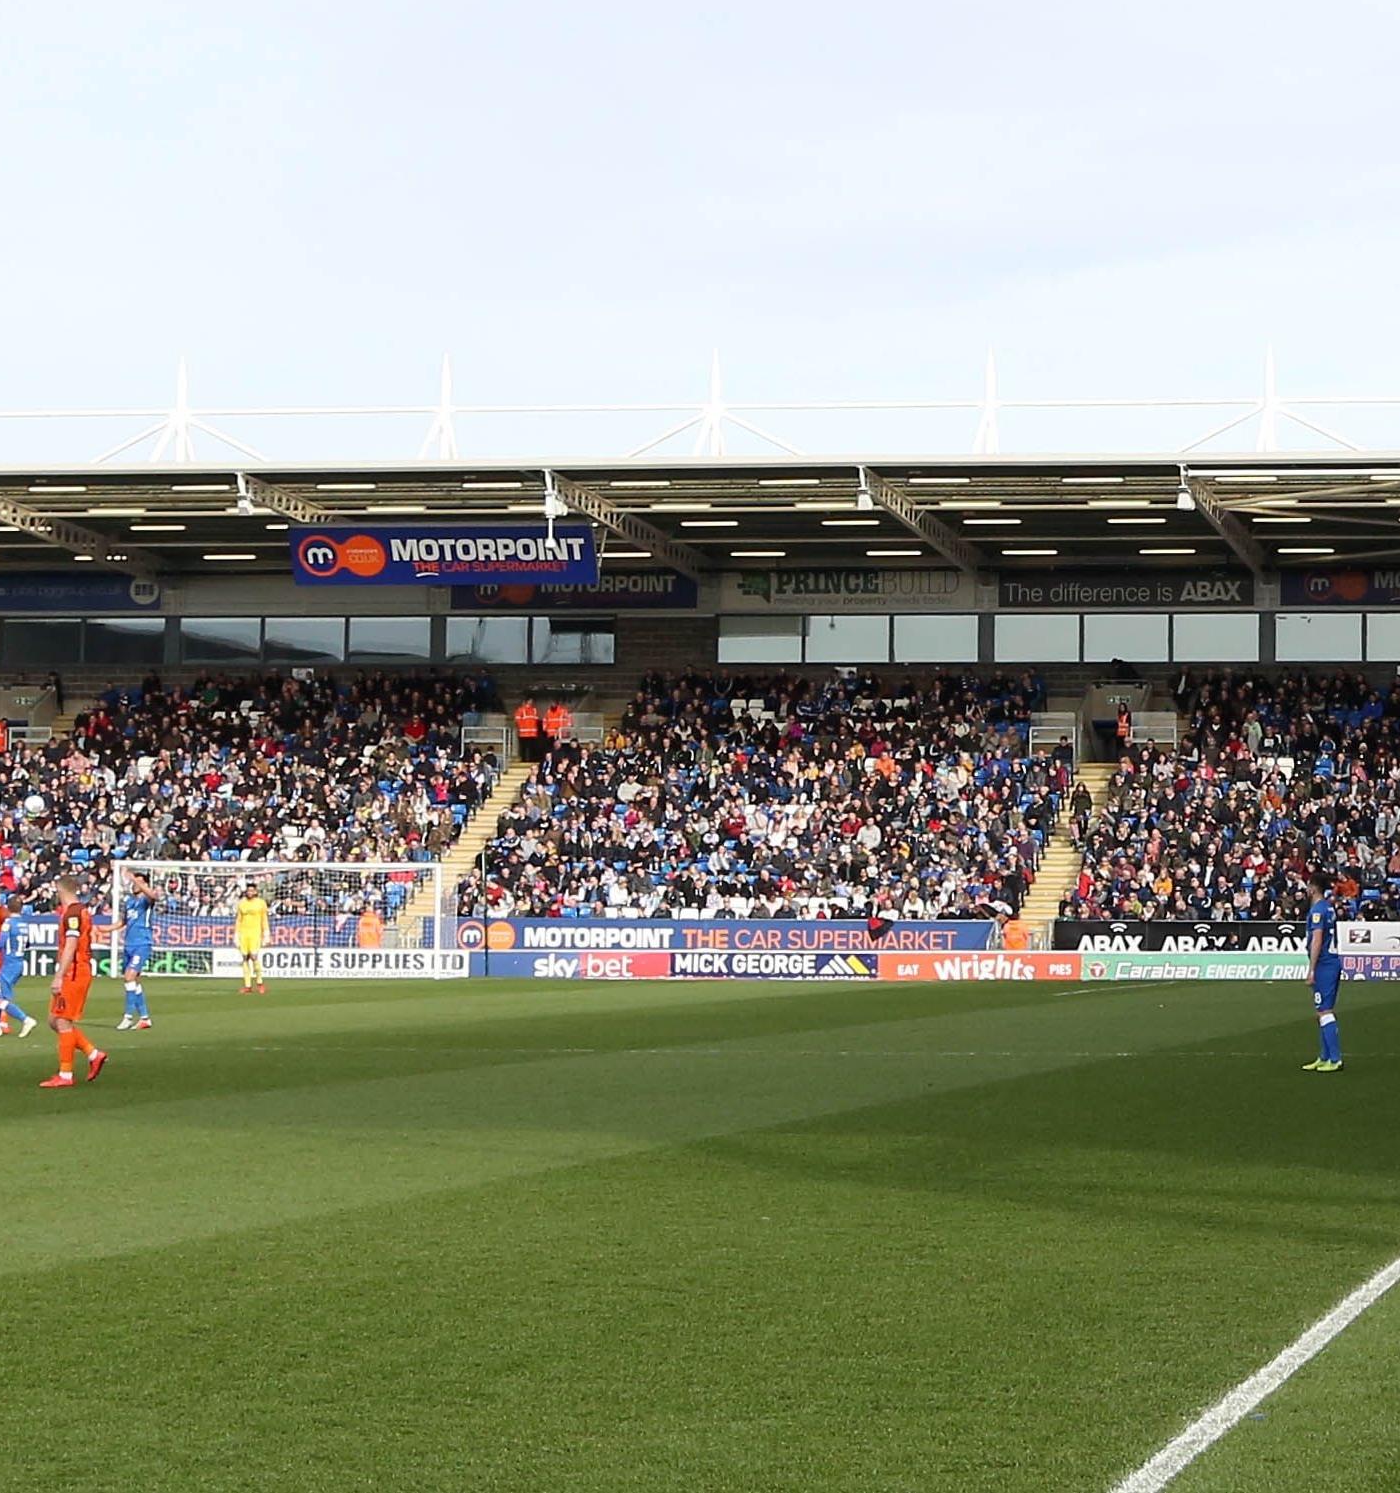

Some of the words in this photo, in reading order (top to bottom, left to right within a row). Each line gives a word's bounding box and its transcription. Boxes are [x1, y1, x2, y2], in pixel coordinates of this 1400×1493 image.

[390, 537, 585, 562] MOTORPOINT
[413, 561, 440, 573] THE
[441, 561, 470, 573] CAR
[473, 561, 568, 573] SUPERMARKET
[775, 571, 960, 595] PRINCEBUILD
[1004, 582, 1043, 602] The
[1049, 582, 1151, 602] difference
[1157, 582, 1173, 602] is
[1179, 580, 1241, 601] ABAX
[167, 924, 330, 946] SUPERARKET
[523, 926, 674, 949] MOTORPOINT
[681, 928, 729, 949] THE
[734, 929, 782, 949] CAR
[787, 930, 958, 950] SUPERMARKET
[1077, 934, 1144, 952] ABAX
[1245, 935, 1309, 952] ABAX
[263, 952, 323, 969] OCATE
[330, 952, 425, 970] SUPPLIES
[533, 954, 580, 978] sky
[586, 953, 633, 977] bet
[674, 953, 729, 973] MICK
[731, 954, 817, 974] GEORGE
[897, 963, 920, 976] EAT
[1049, 963, 1072, 976] PIES
[1114, 961, 1200, 980] Carabao
[1205, 964, 1269, 980] ENERGY
[1272, 965, 1309, 979] DRIN
